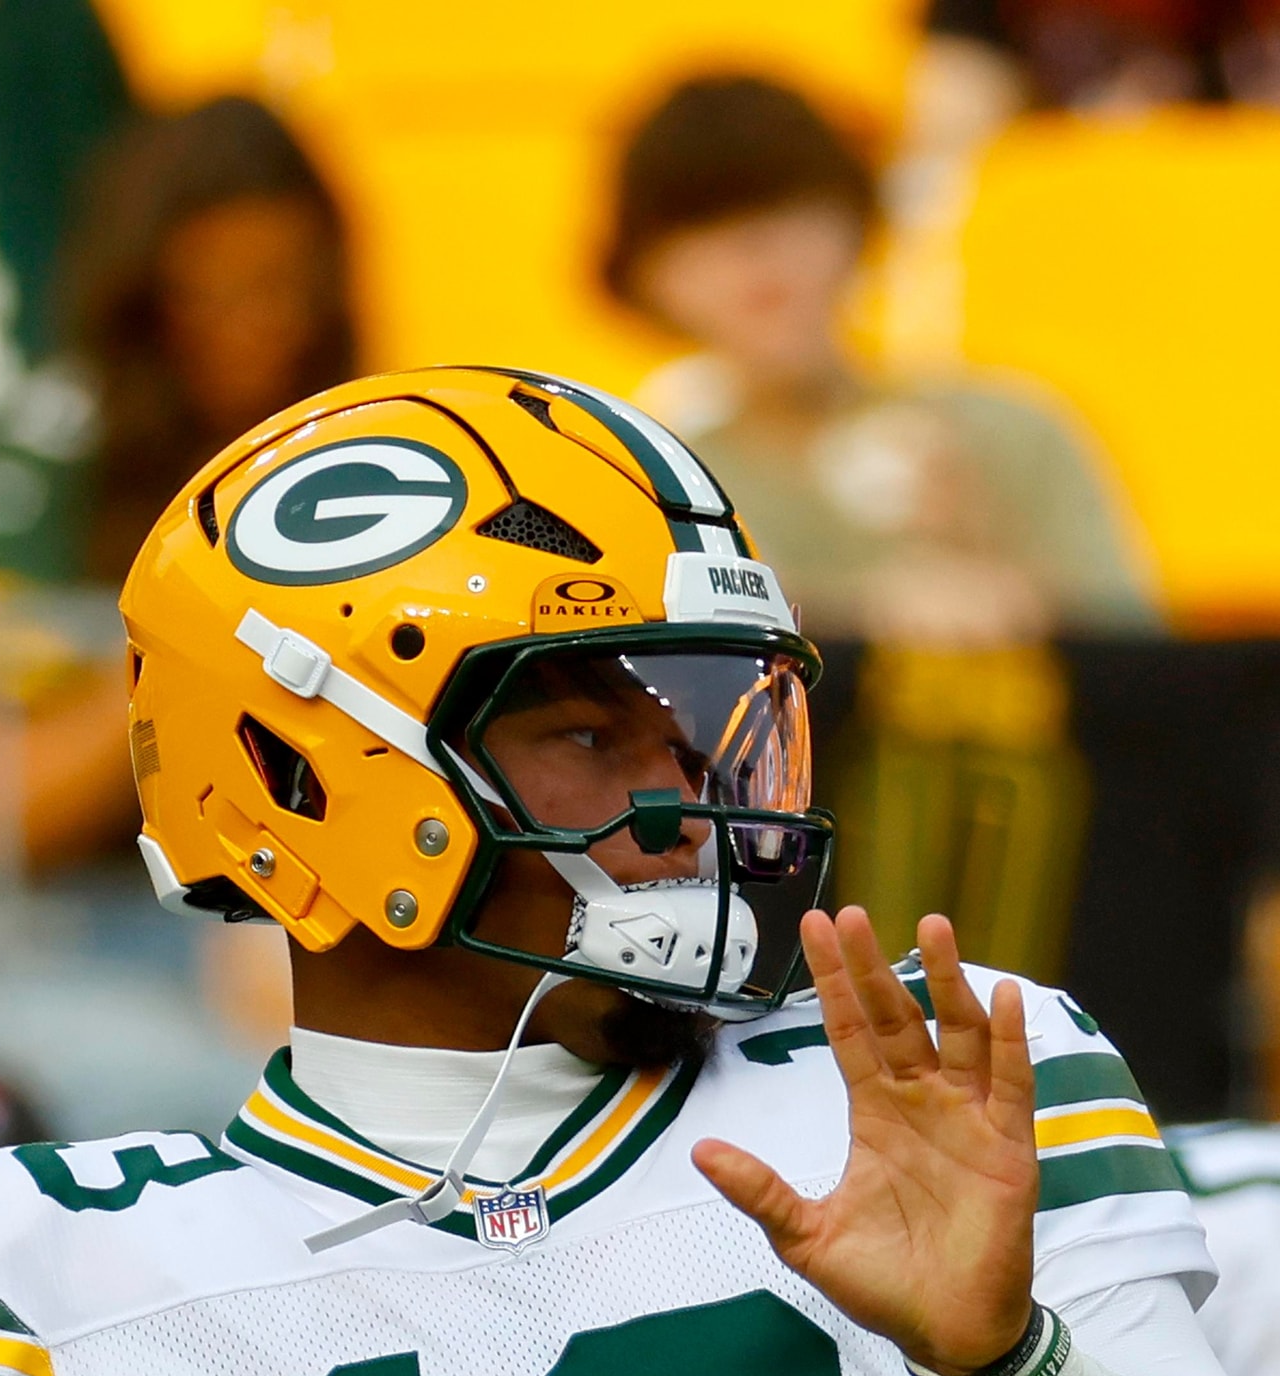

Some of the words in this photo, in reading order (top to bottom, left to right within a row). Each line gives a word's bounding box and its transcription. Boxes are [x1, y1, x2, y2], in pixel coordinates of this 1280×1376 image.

[707, 566, 770, 602] PACKERS
[539, 604, 630, 617] OAKLEY
[13, 1130, 243, 1212] 3
[486, 1204, 538, 1239] NFL
